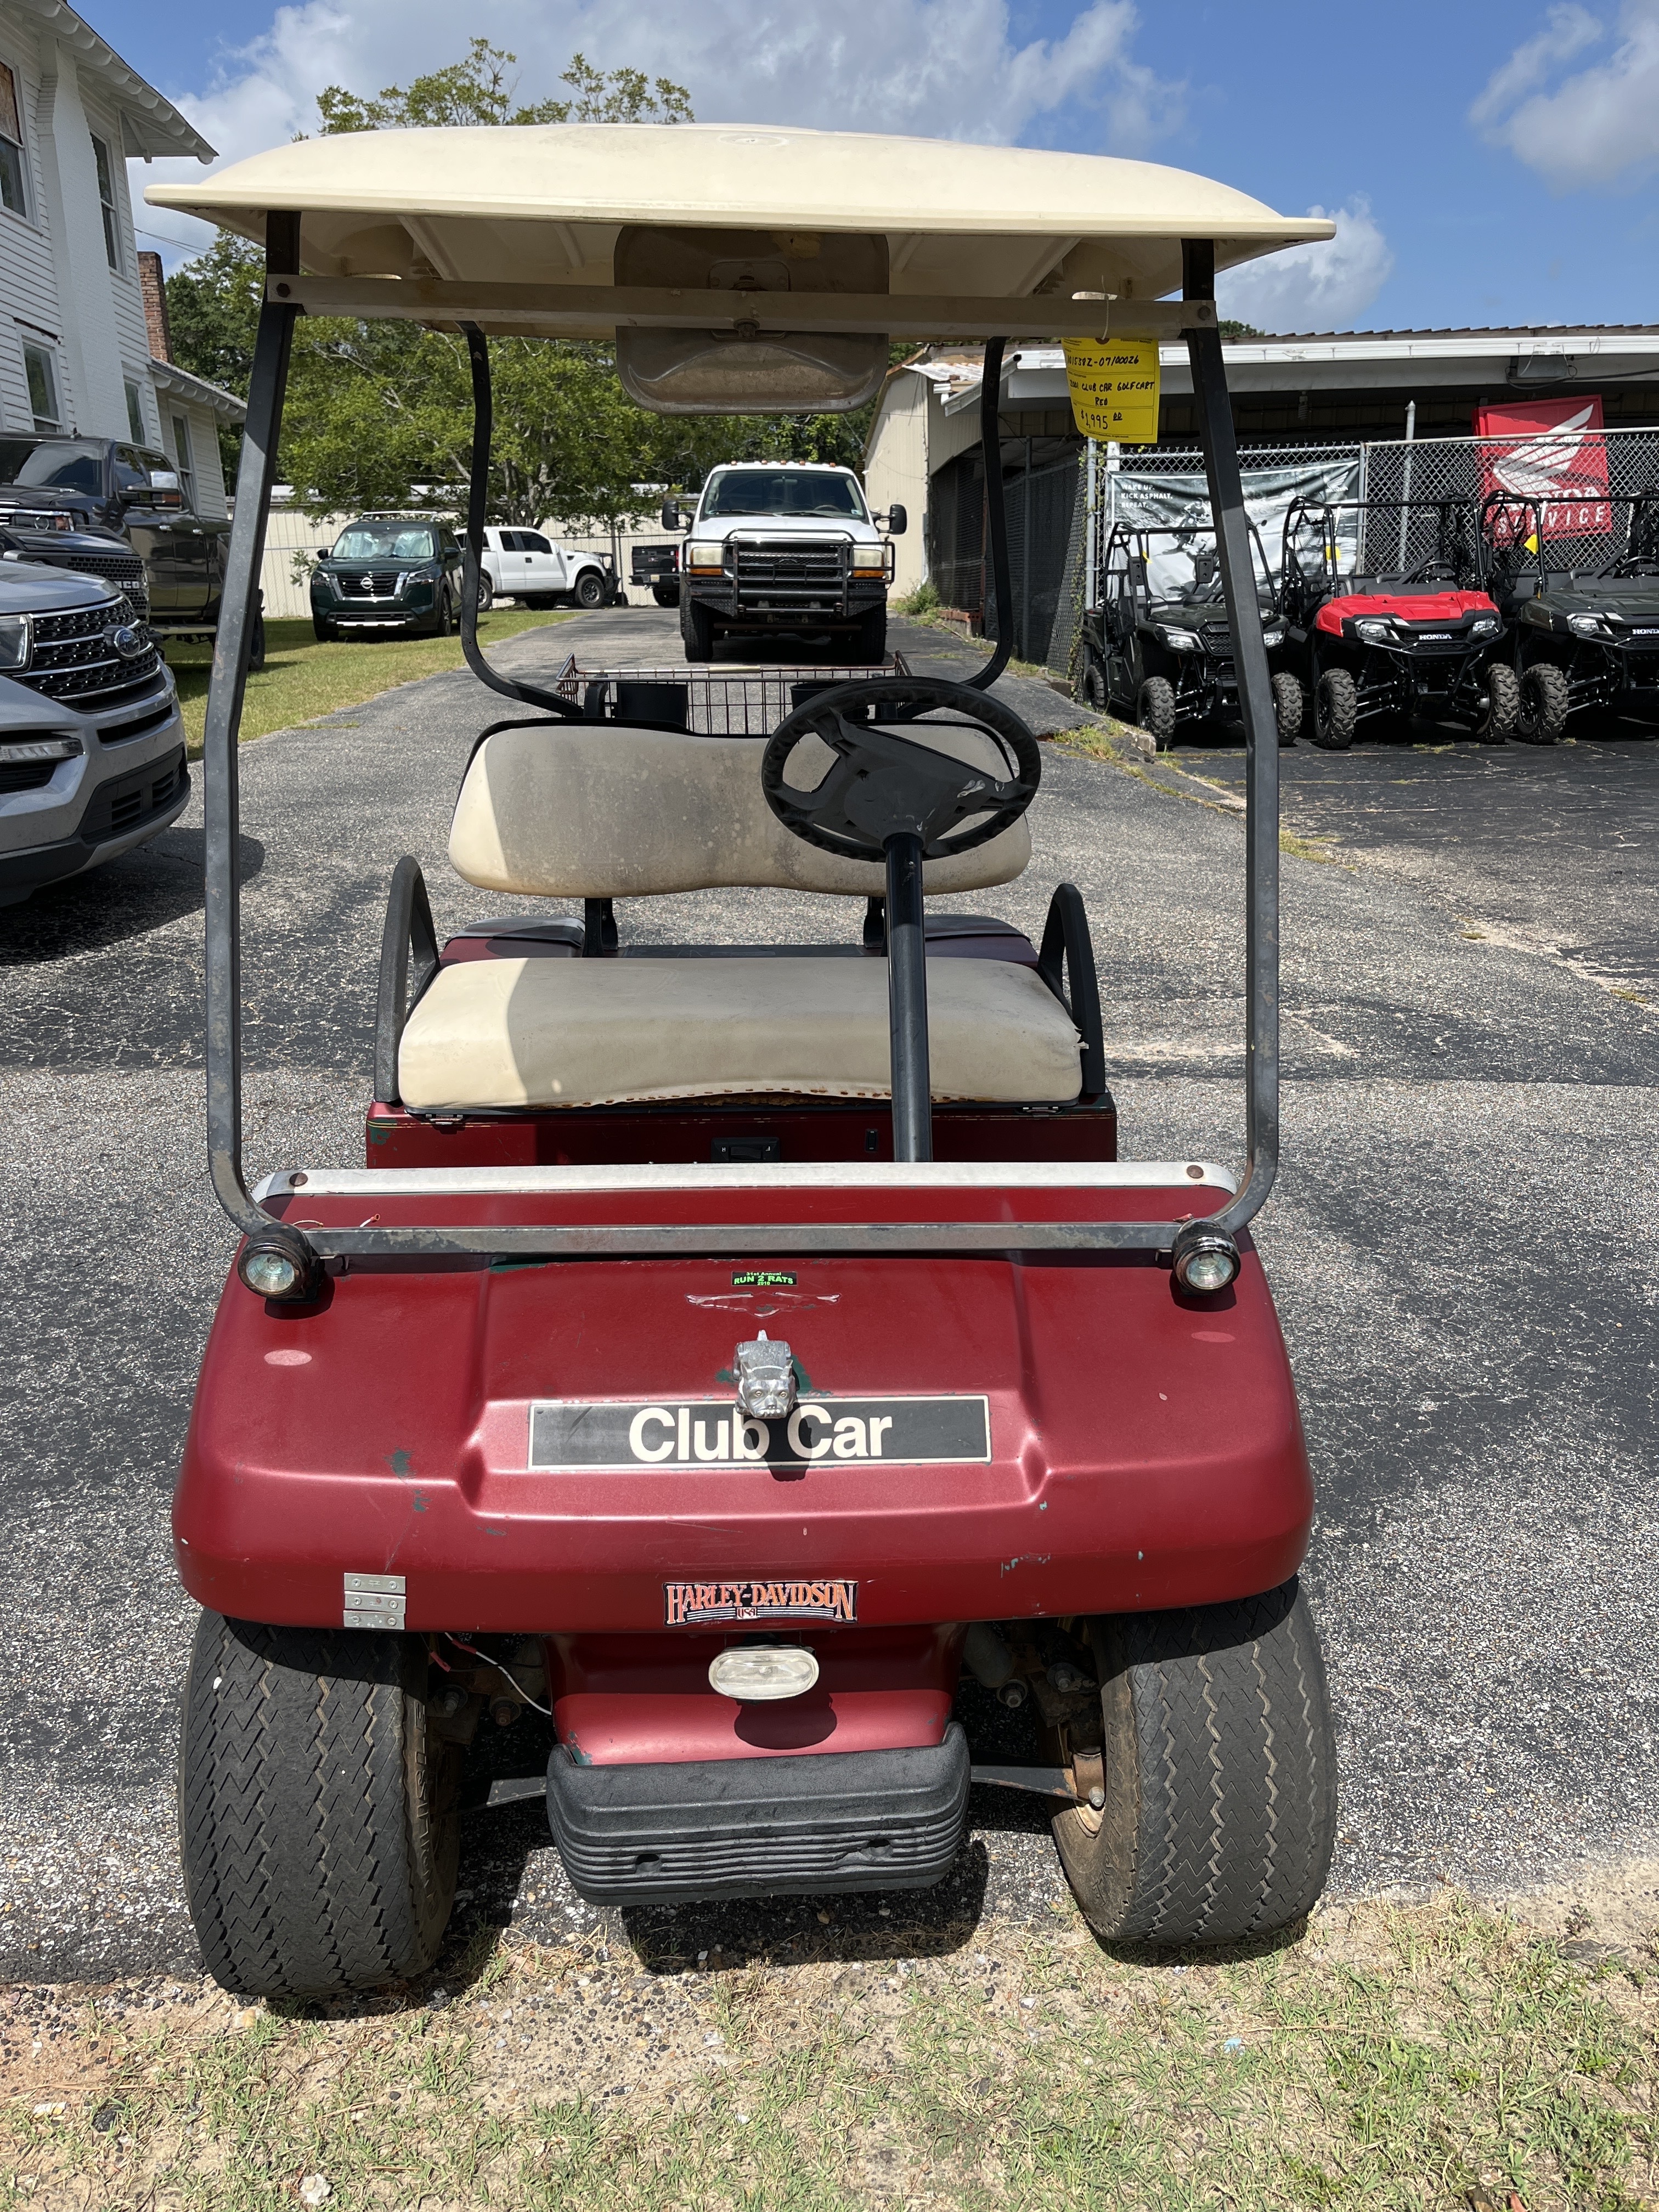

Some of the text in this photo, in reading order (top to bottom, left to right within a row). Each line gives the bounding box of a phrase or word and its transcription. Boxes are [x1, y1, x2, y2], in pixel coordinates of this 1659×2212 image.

[1082, 383, 1097, 392] CLUB
[1099, 382, 1113, 392] CAR
[1095, 397, 1108, 406] RED
[734, 1276, 754, 1284] RUN
[768, 1276, 793, 1284] RATS
[629, 1404, 893, 1463] Club Car
[666, 1582, 854, 1624] HARLEY-DAVIDSON
[737, 1607, 756, 1618] USA
